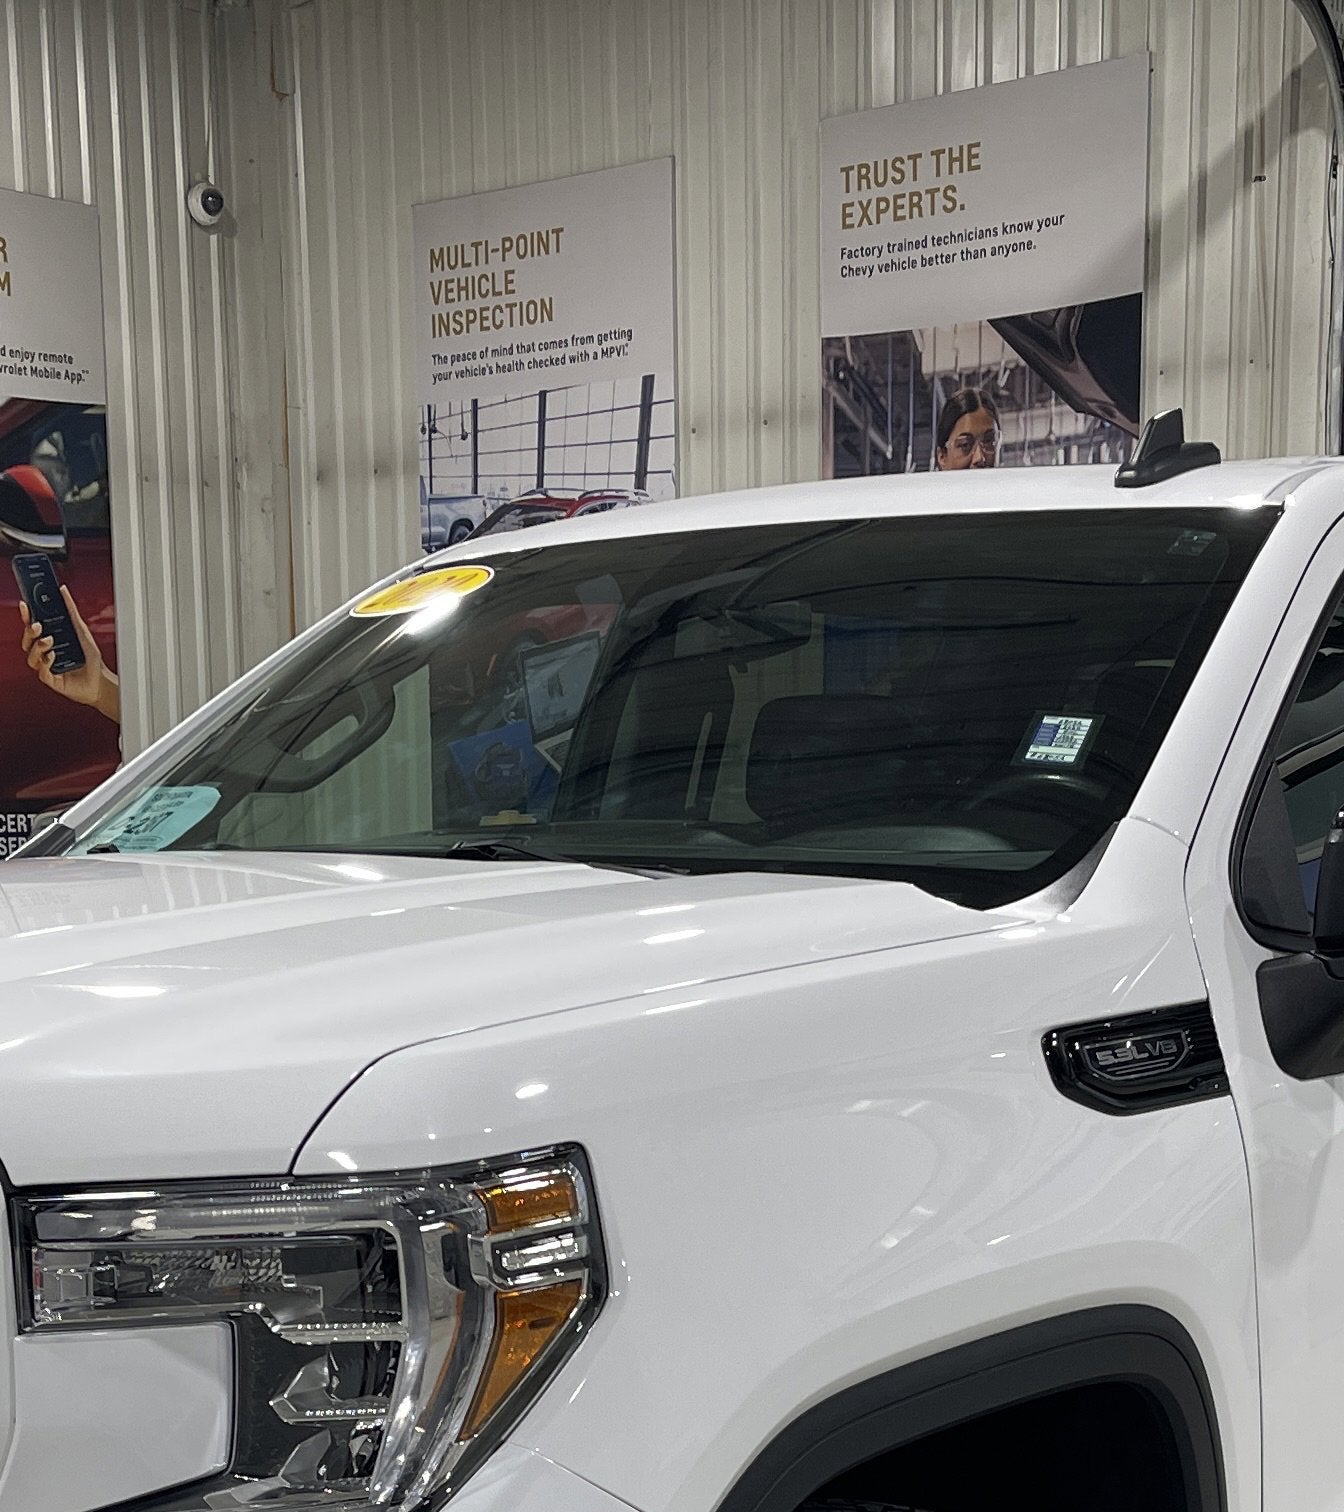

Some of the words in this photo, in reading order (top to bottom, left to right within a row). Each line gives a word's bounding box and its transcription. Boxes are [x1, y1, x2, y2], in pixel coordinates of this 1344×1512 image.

[840, 152, 923, 194] TRUST
[931, 141, 981, 178] THE
[841, 185, 965, 230] EXPERTS.
[430, 227, 564, 273] MULTI-POINT
[840, 243, 884, 261] Factory
[887, 235, 928, 254] trained
[931, 225, 998, 247] technicians
[1002, 219, 1034, 236] know
[1037, 214, 1065, 233] your
[840, 264, 874, 279] Chevy
[877, 256, 917, 274] vehicle
[921, 250, 957, 268] better
[960, 244, 987, 262] than
[990, 239, 1037, 259] anyone.
[430, 269, 516, 306] VEHICLE
[432, 296, 554, 338] INSPECTION
[9, 347, 35, 363] enjoy
[38, 352, 74, 365] remote
[432, 354, 448, 366] The
[451, 352, 477, 367] peace
[479, 347, 488, 360] of
[491, 345, 514, 358] mind
[516, 341, 536, 354] that
[538, 338, 569, 351] comes
[571, 333, 595, 347] from
[597, 328, 633, 346] getting
[432, 370, 453, 385] your
[454, 364, 493, 379] vehicle's
[495, 359, 525, 374] health
[527, 354, 566, 370] checked
[569, 349, 590, 363] with
[592, 351, 599, 361] a
[30, 365, 62, 380] Mobile
